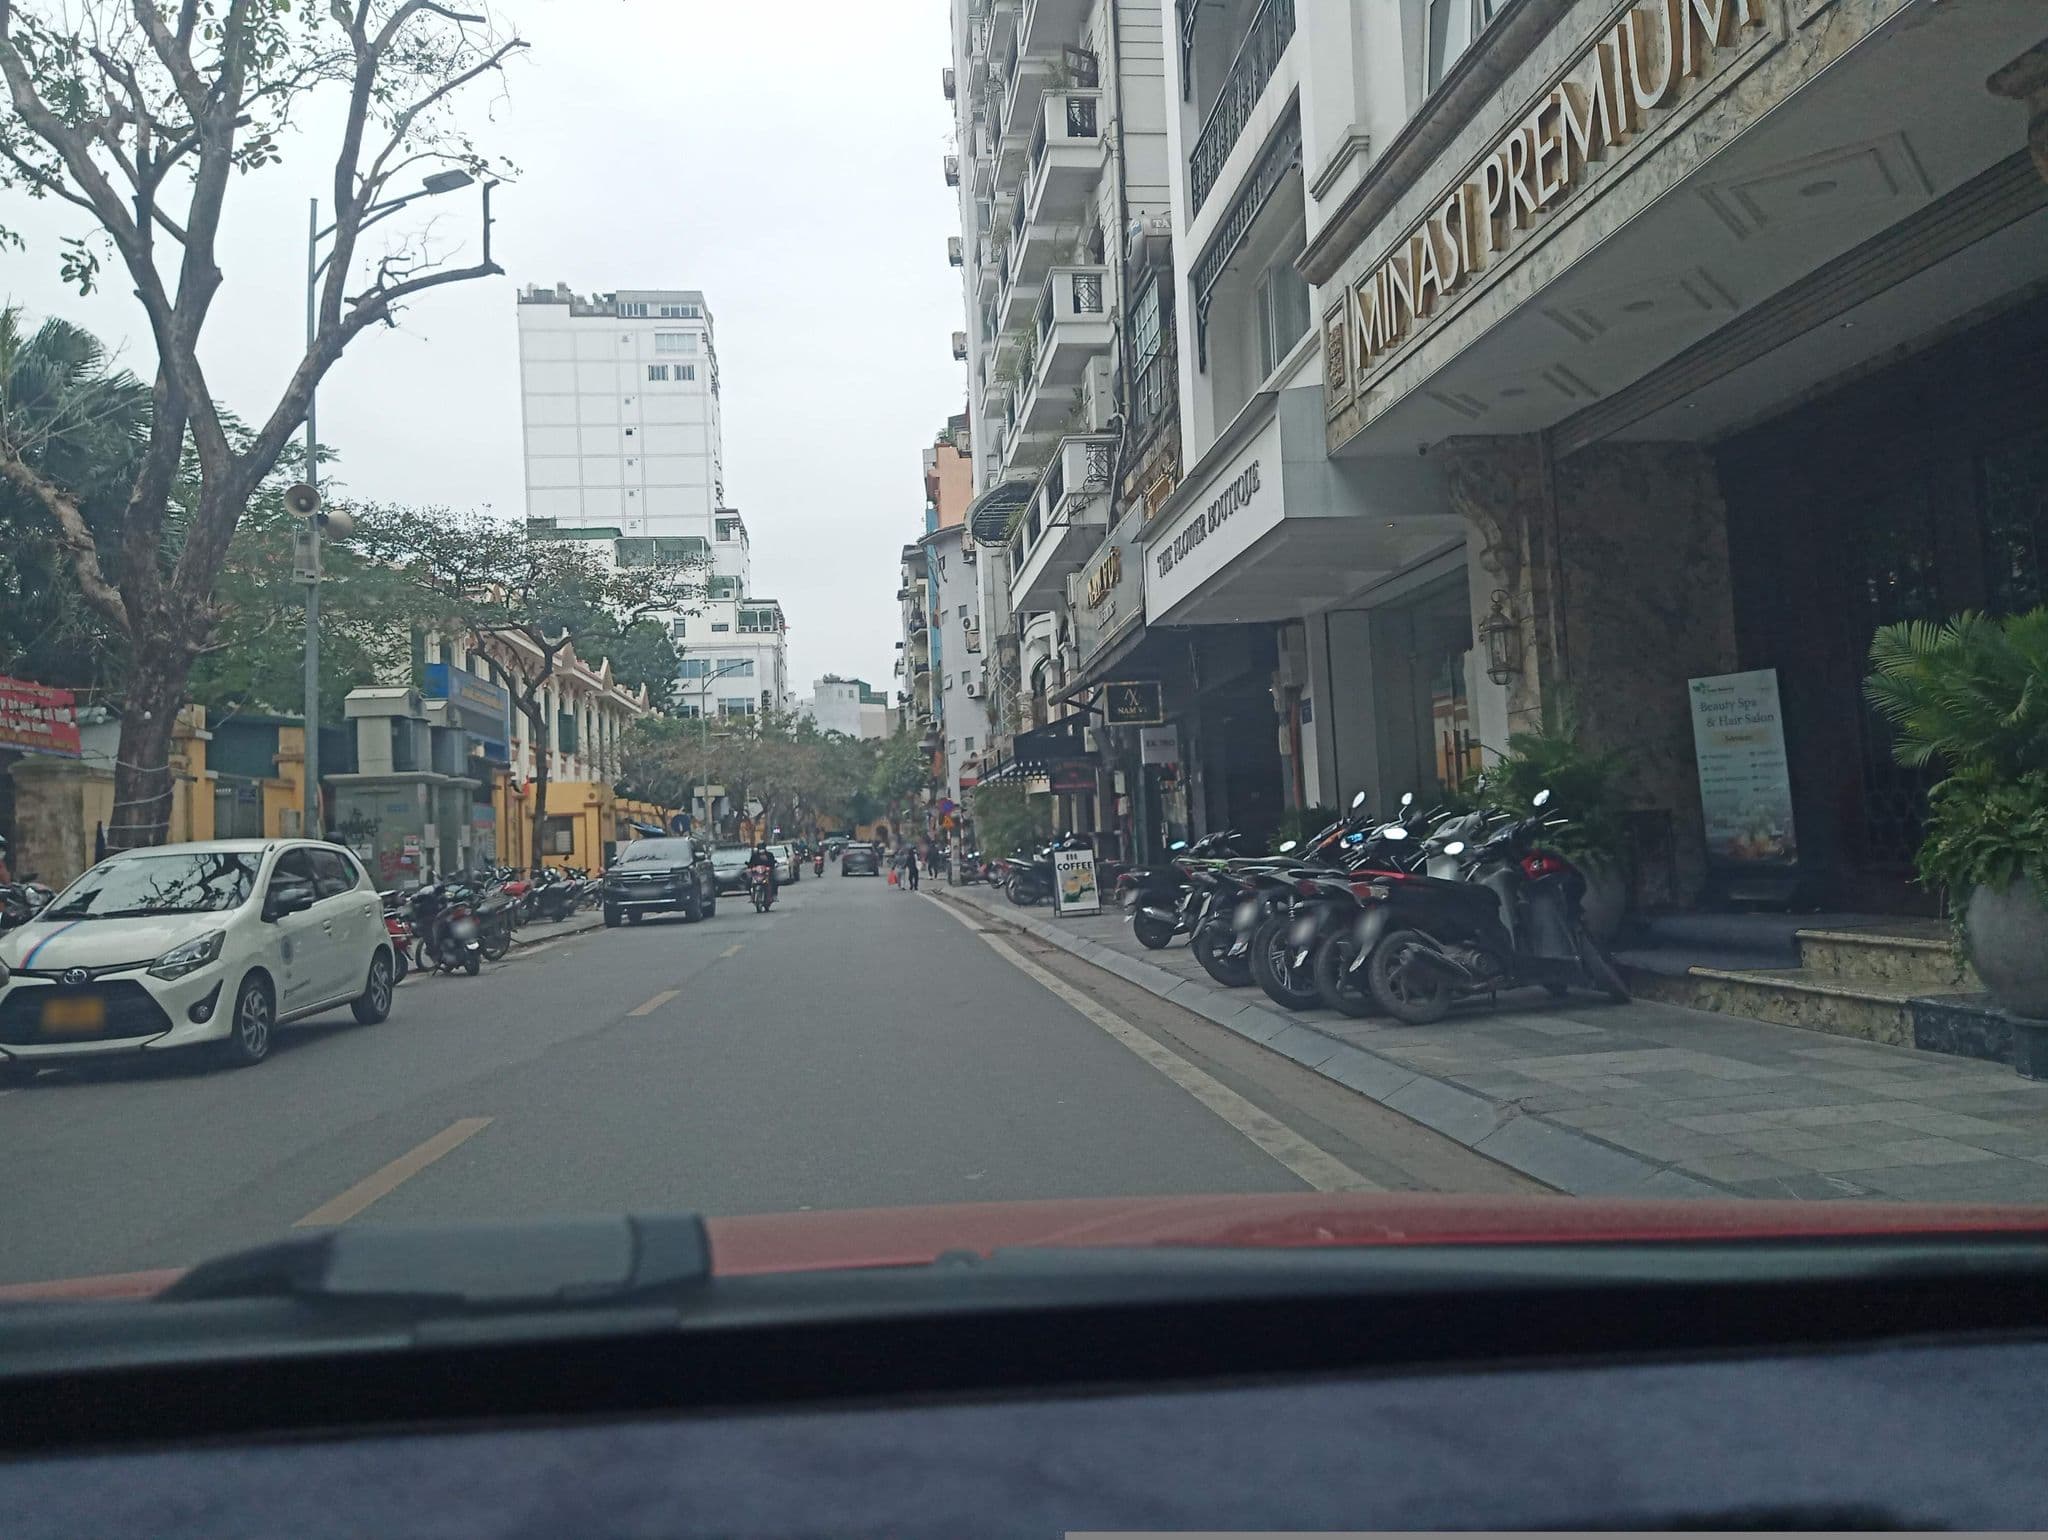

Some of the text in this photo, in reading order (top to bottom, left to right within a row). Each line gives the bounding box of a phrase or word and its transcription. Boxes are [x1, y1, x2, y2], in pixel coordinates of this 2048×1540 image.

[1355, 184, 1475, 369] MINASI
[1157, 459, 1260, 578] THE FLOWER BOUTIQUE
[1719, 714, 1744, 727] Hair
[1057, 861, 1093, 871] COFFEE
